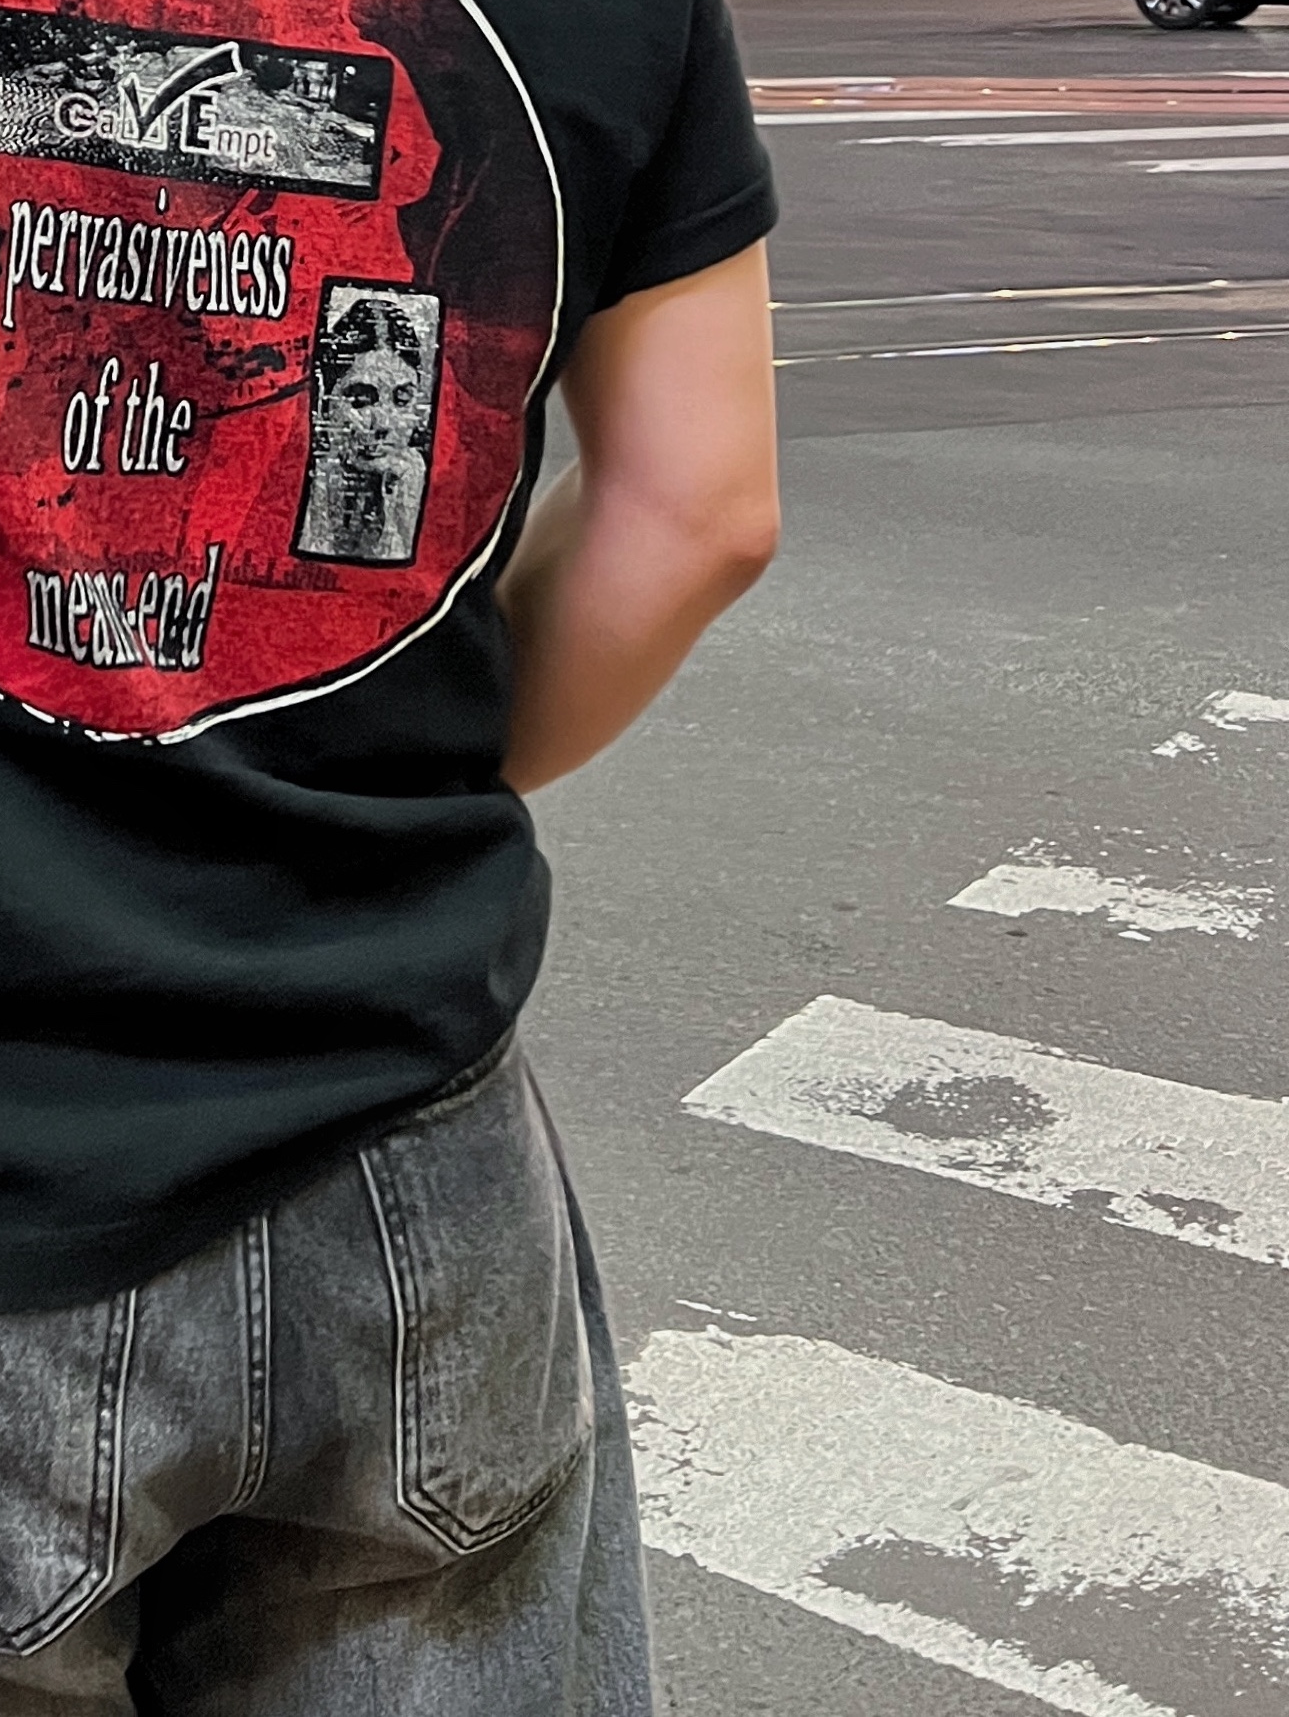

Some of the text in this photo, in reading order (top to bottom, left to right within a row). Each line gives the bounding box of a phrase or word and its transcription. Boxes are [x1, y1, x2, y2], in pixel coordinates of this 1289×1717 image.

[2, 187, 291, 328] pervasiveness
[64, 357, 191, 472] of the
